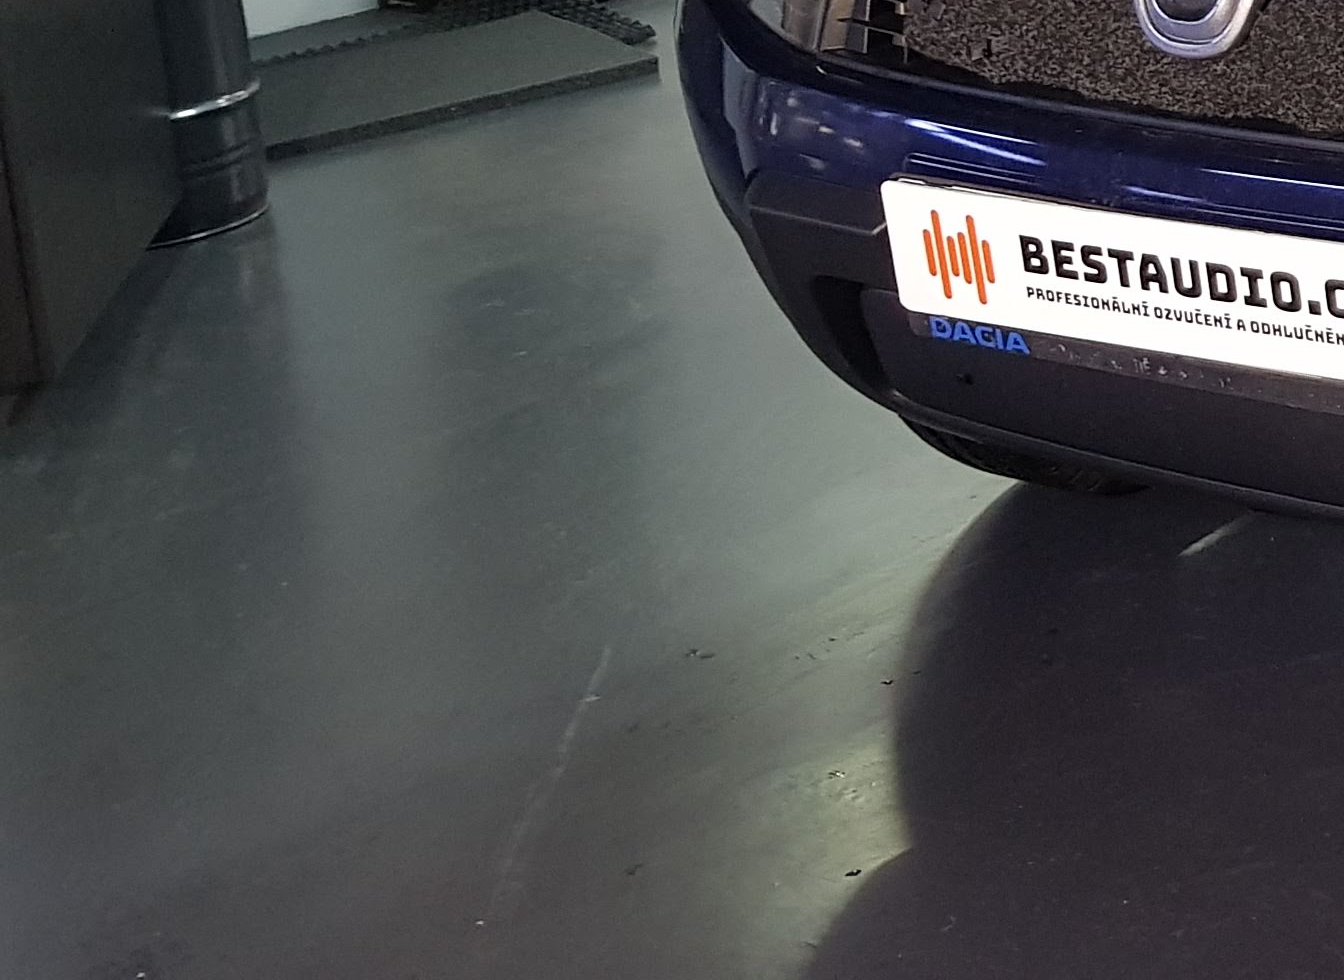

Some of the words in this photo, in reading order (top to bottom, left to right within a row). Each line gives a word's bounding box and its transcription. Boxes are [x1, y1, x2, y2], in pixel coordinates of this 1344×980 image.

[1026, 285, 1150, 318] PROFESIONÁLNÍ
[1153, 305, 1233, 330] OZVUČENÍ
[1236, 318, 1247, 332] A
[928, 315, 1032, 356] DACIA
